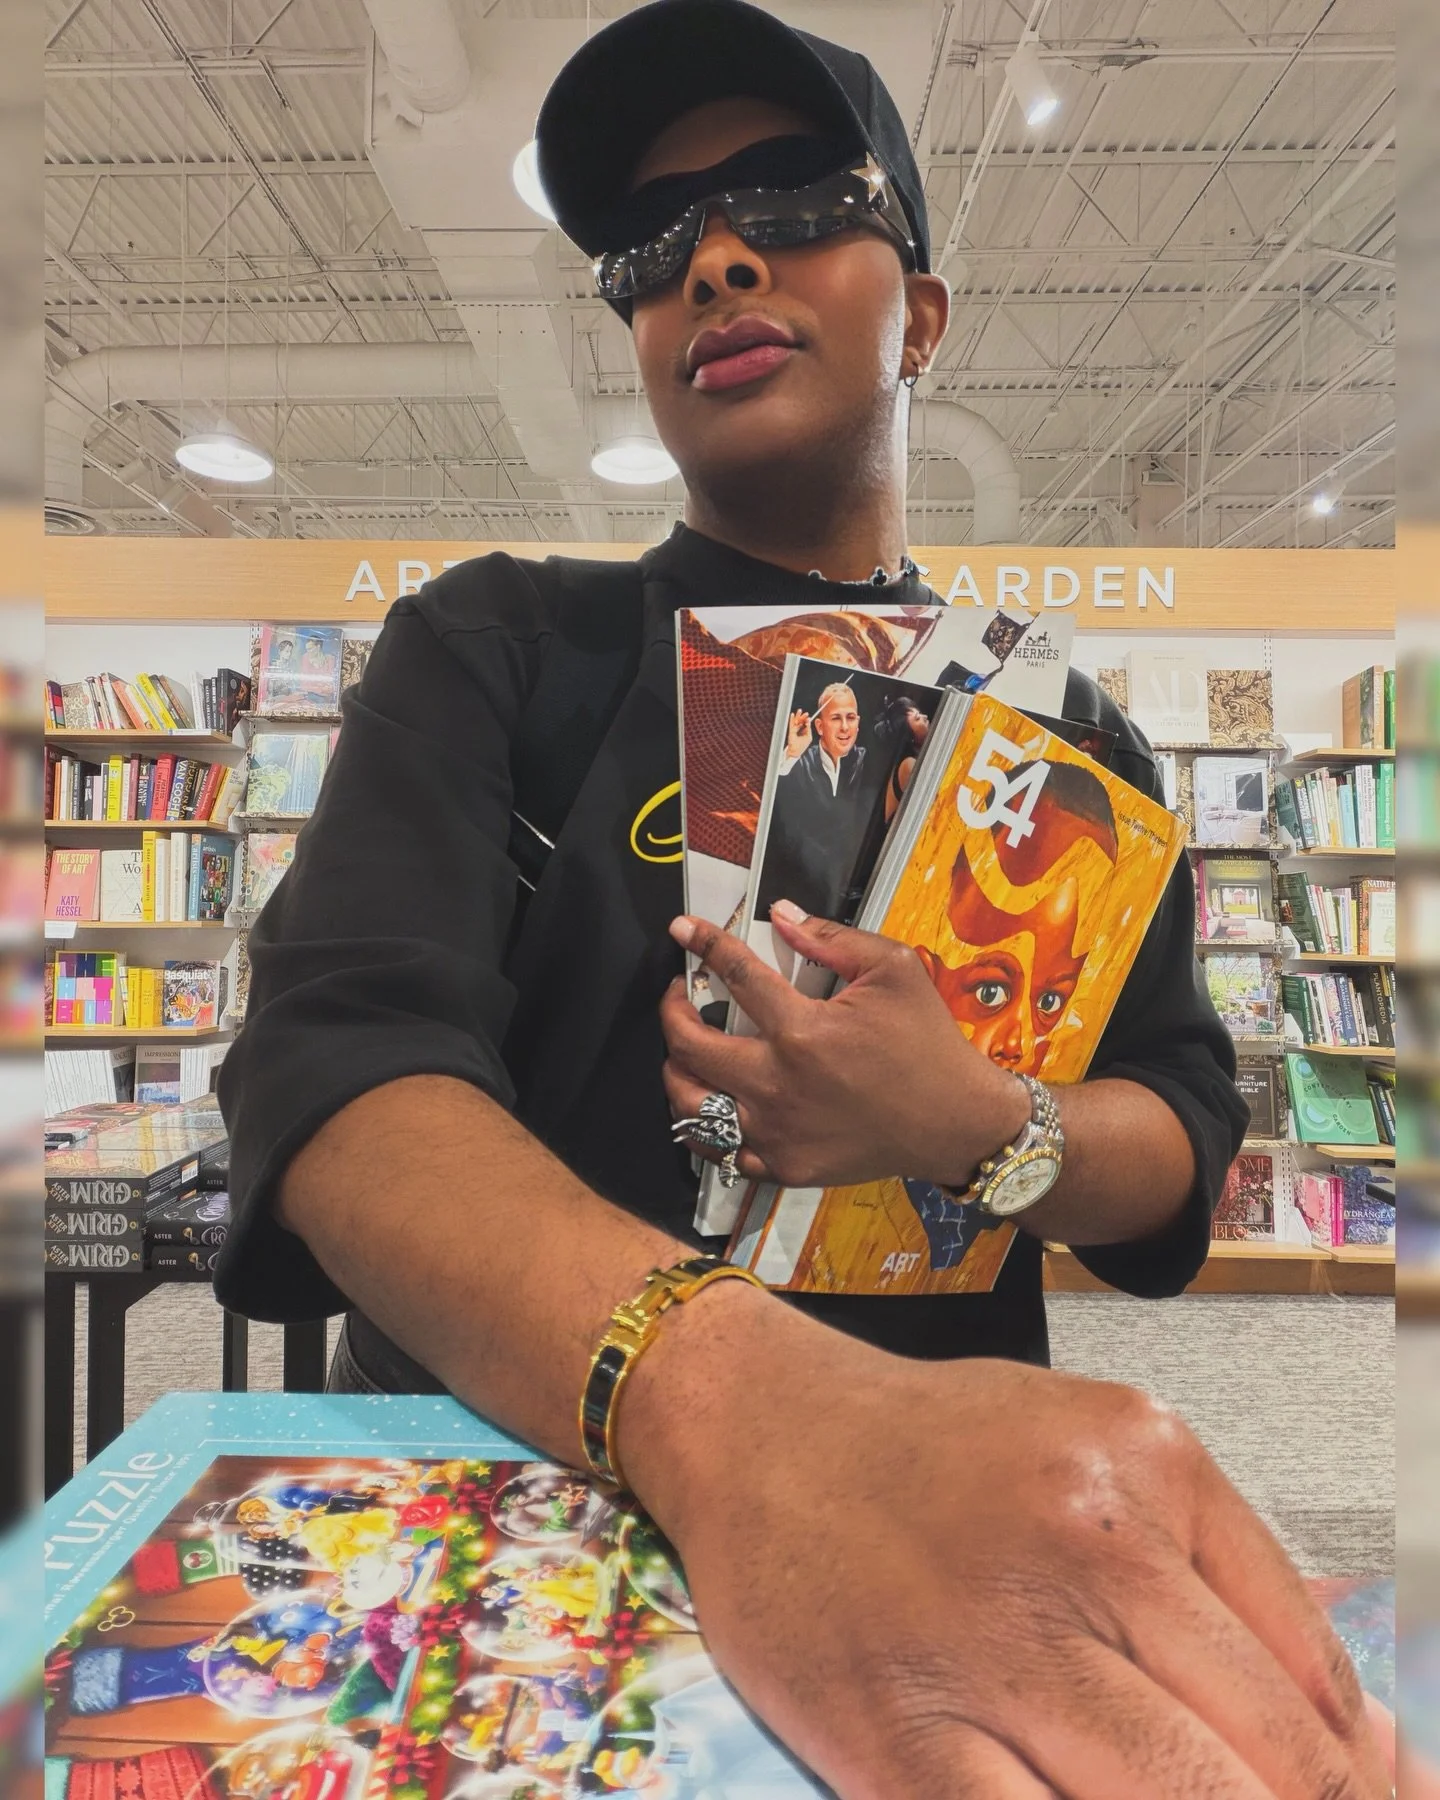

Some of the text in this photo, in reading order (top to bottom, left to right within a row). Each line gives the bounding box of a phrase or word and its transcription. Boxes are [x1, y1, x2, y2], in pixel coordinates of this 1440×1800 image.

[345, 560, 462, 601] AR
[1026, 660, 1045, 668] PARIS
[170, 760, 188, 811] VAN GOGH
[957, 728, 1051, 848] 54
[1118, 811, 1132, 827] Issue
[56, 854, 94, 864] THE STORY
[62, 864, 87, 875] OF ART
[123, 864, 143, 874] Wo
[1367, 880, 1390, 888] NATIVE
[61, 896, 79, 906] KATY
[133, 903, 142, 913] A
[56, 906, 82, 917] HESSEL
[165, 969, 209, 983] Basquiat
[1373, 972, 1387, 1025] PLANTOPEDIA
[1332, 1113, 1352, 1136] GARDEN
[1235, 1157, 1272, 1172] OME
[52, 1182, 70, 1201] ASTER
[69, 1180, 132, 1204] GRIM
[49, 1213, 68, 1232] ASTER
[67, 1211, 128, 1236] GRIM
[50, 1245, 69, 1263] ASTER
[68, 1243, 130, 1268] GRIM
[881, 1252, 921, 1273] ART
